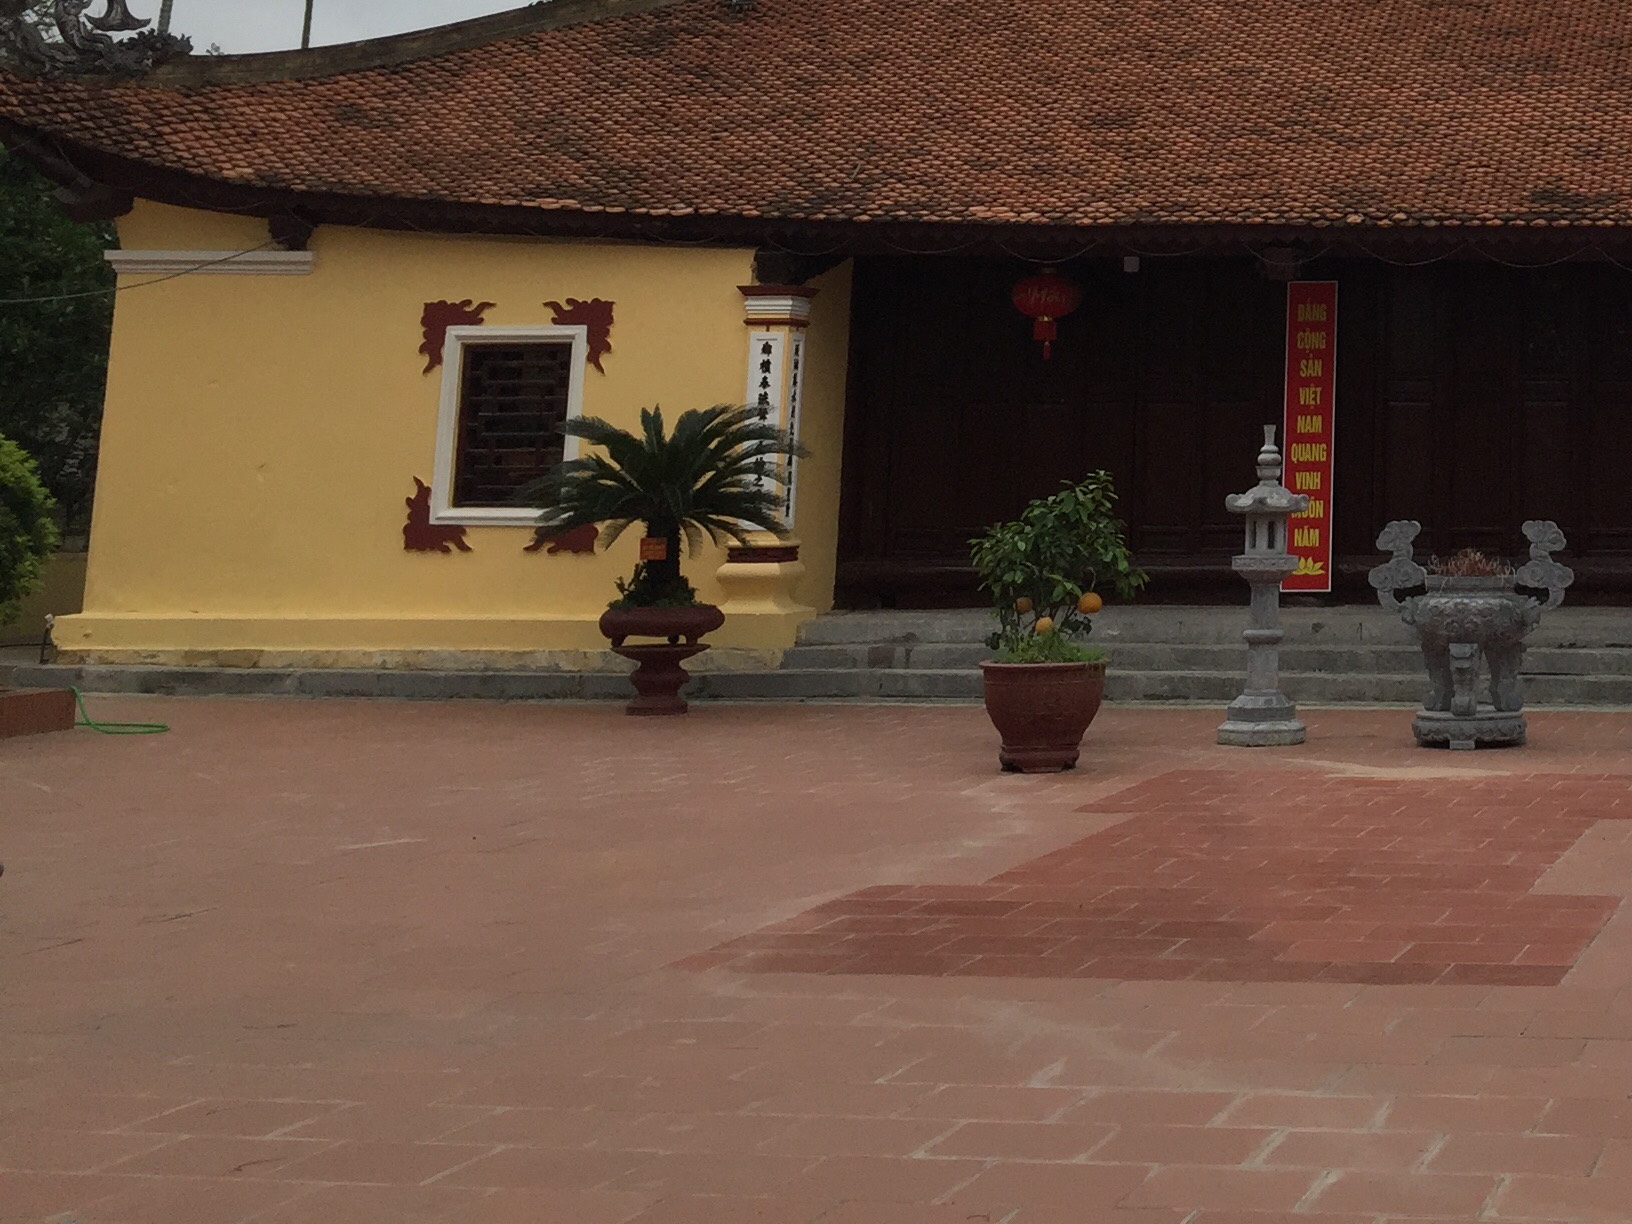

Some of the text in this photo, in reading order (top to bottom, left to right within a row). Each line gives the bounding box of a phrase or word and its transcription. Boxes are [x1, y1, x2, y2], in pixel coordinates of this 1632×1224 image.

[1297, 297, 1327, 322] ĐẢNG
[1297, 327, 1326, 353] CỘNG
[1300, 352, 1322, 377] SẢN
[1299, 383, 1322, 409] VIỆT
[1297, 415, 1322, 433] NAM
[1291, 443, 1327, 462] QUANG
[1296, 471, 1321, 490] VINH
[1294, 525, 1320, 547] NĂM
